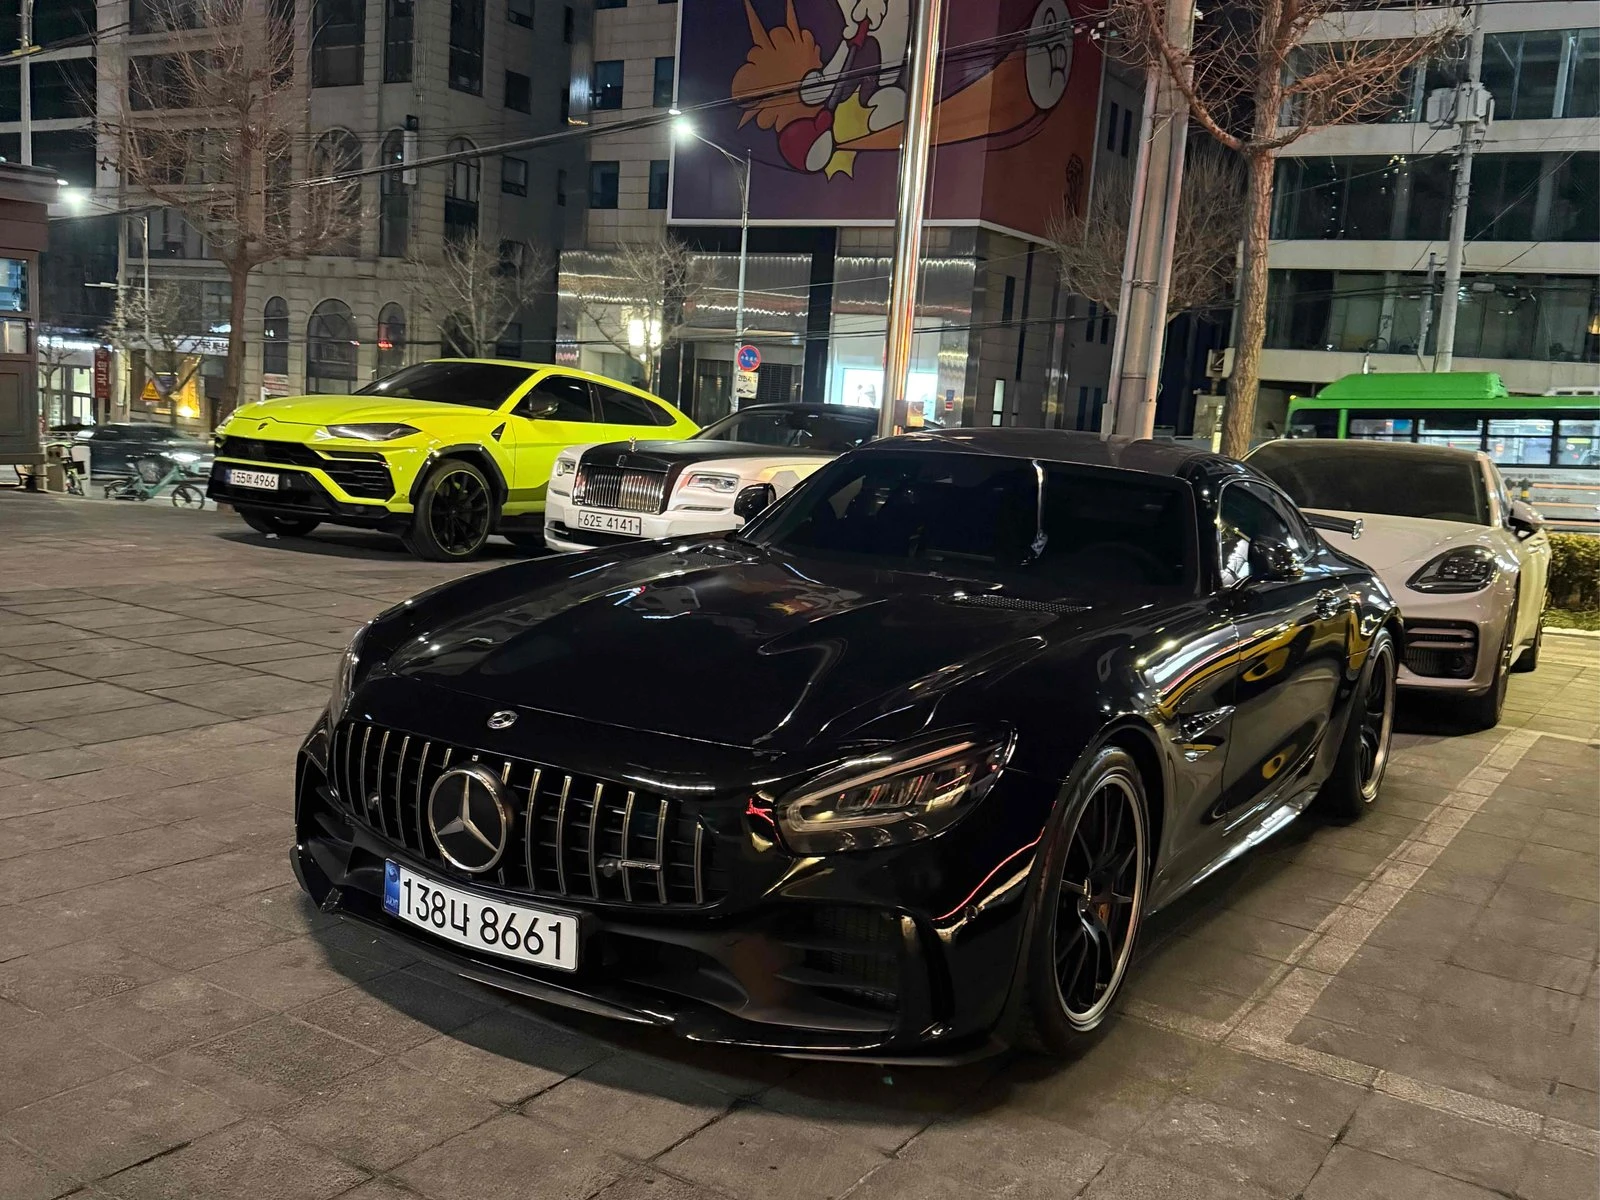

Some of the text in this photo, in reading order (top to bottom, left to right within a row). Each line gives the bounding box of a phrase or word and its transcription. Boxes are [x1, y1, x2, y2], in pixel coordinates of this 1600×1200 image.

[254, 474, 276, 488] 4966
[583, 514, 633, 531] 62도 4141
[403, 878, 561, 960] 138나 8661
